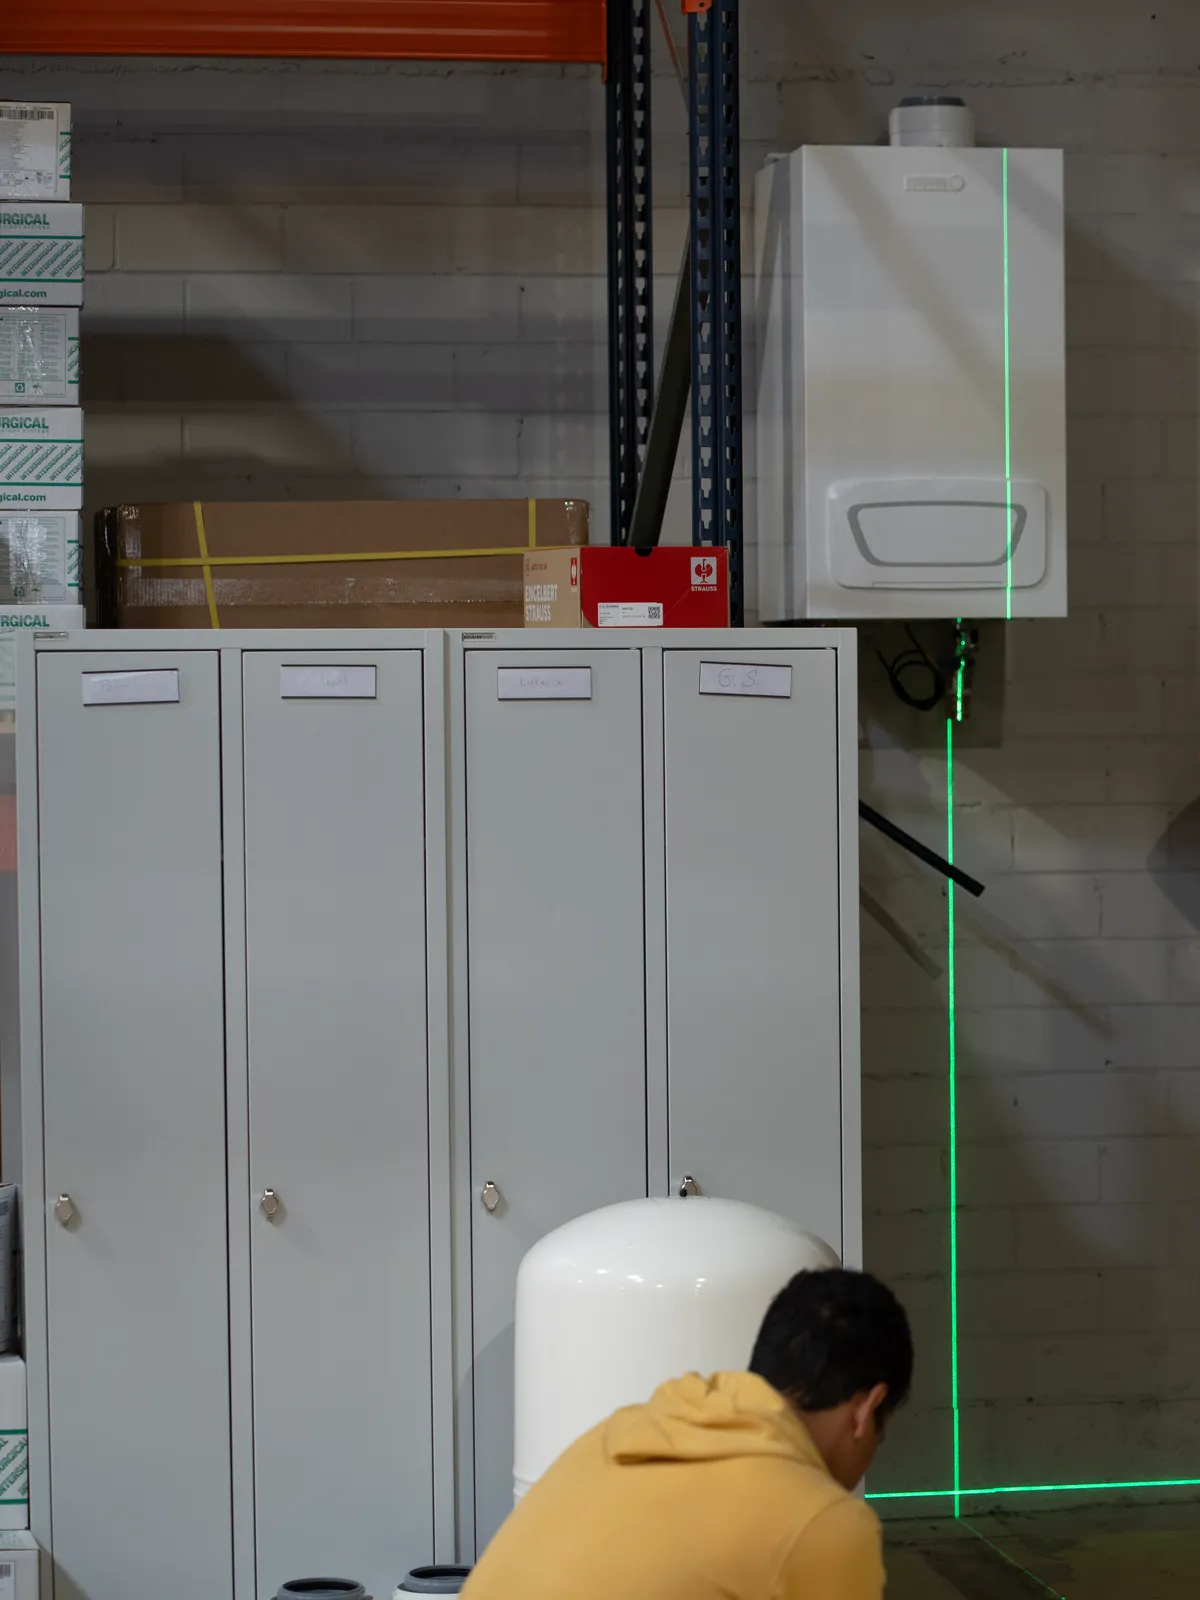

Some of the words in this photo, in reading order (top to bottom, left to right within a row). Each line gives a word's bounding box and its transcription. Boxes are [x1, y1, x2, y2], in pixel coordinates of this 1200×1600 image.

[5, 444, 43, 480] INTERSURGICAL
[20, 444, 58, 480] INTERSURGICAL
[34, 444, 72, 481] INTERSURGICAL
[525, 584, 558, 602] ENGELBERT
[0, 615, 50, 627] RGICAL
[525, 603, 551, 622] STRAUSS
